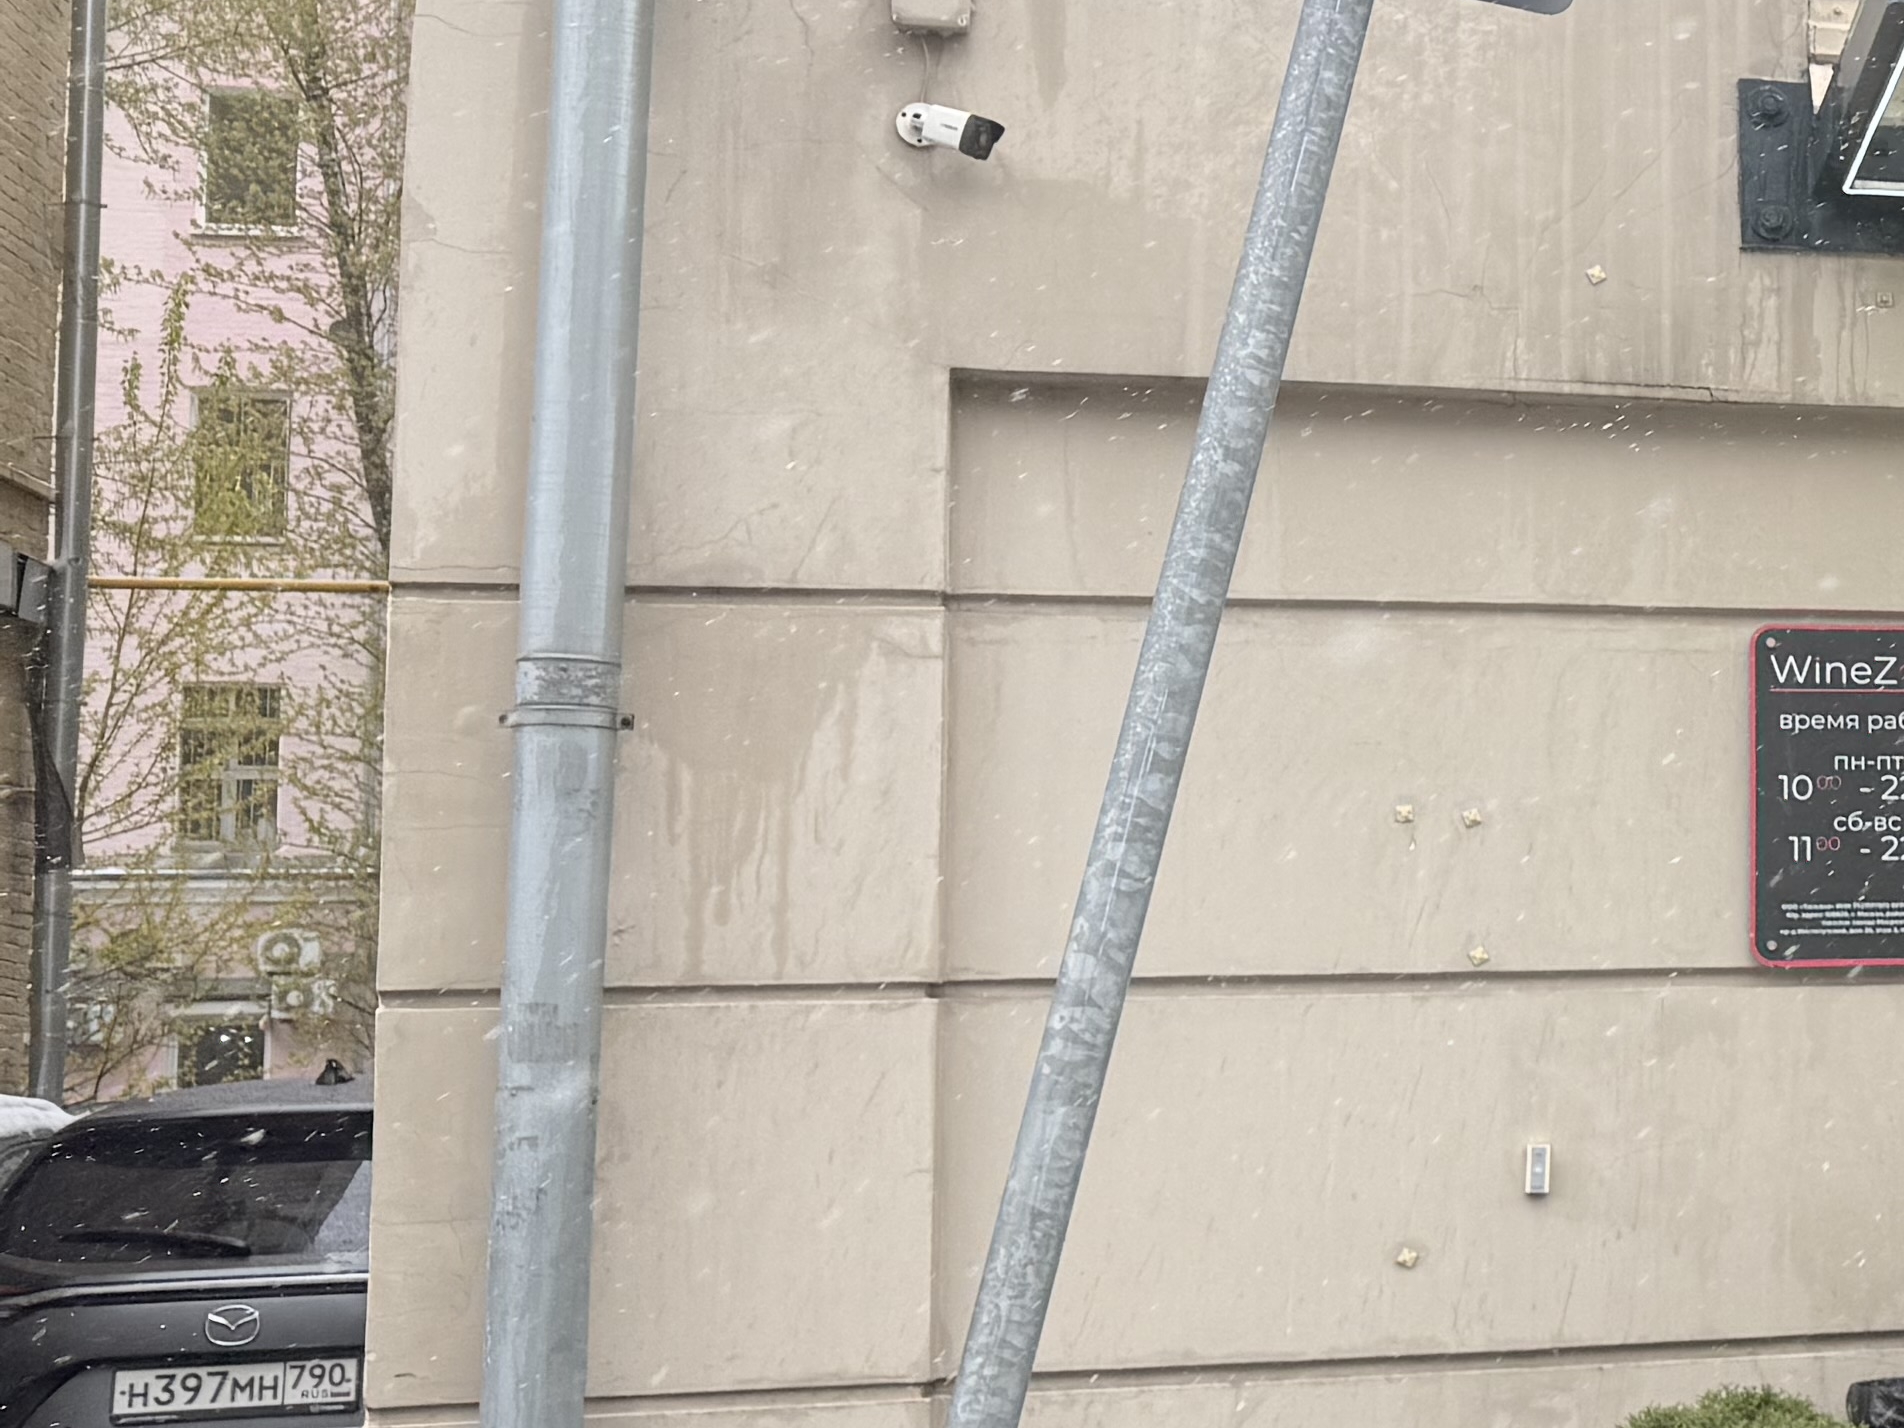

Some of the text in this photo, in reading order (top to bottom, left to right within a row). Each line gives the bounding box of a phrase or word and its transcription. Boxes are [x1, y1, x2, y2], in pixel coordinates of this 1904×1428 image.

[1779, 713, 1860, 733] время
[1833, 754, 1904, 771] пн-пт
[288, 1362, 346, 1390] 790
